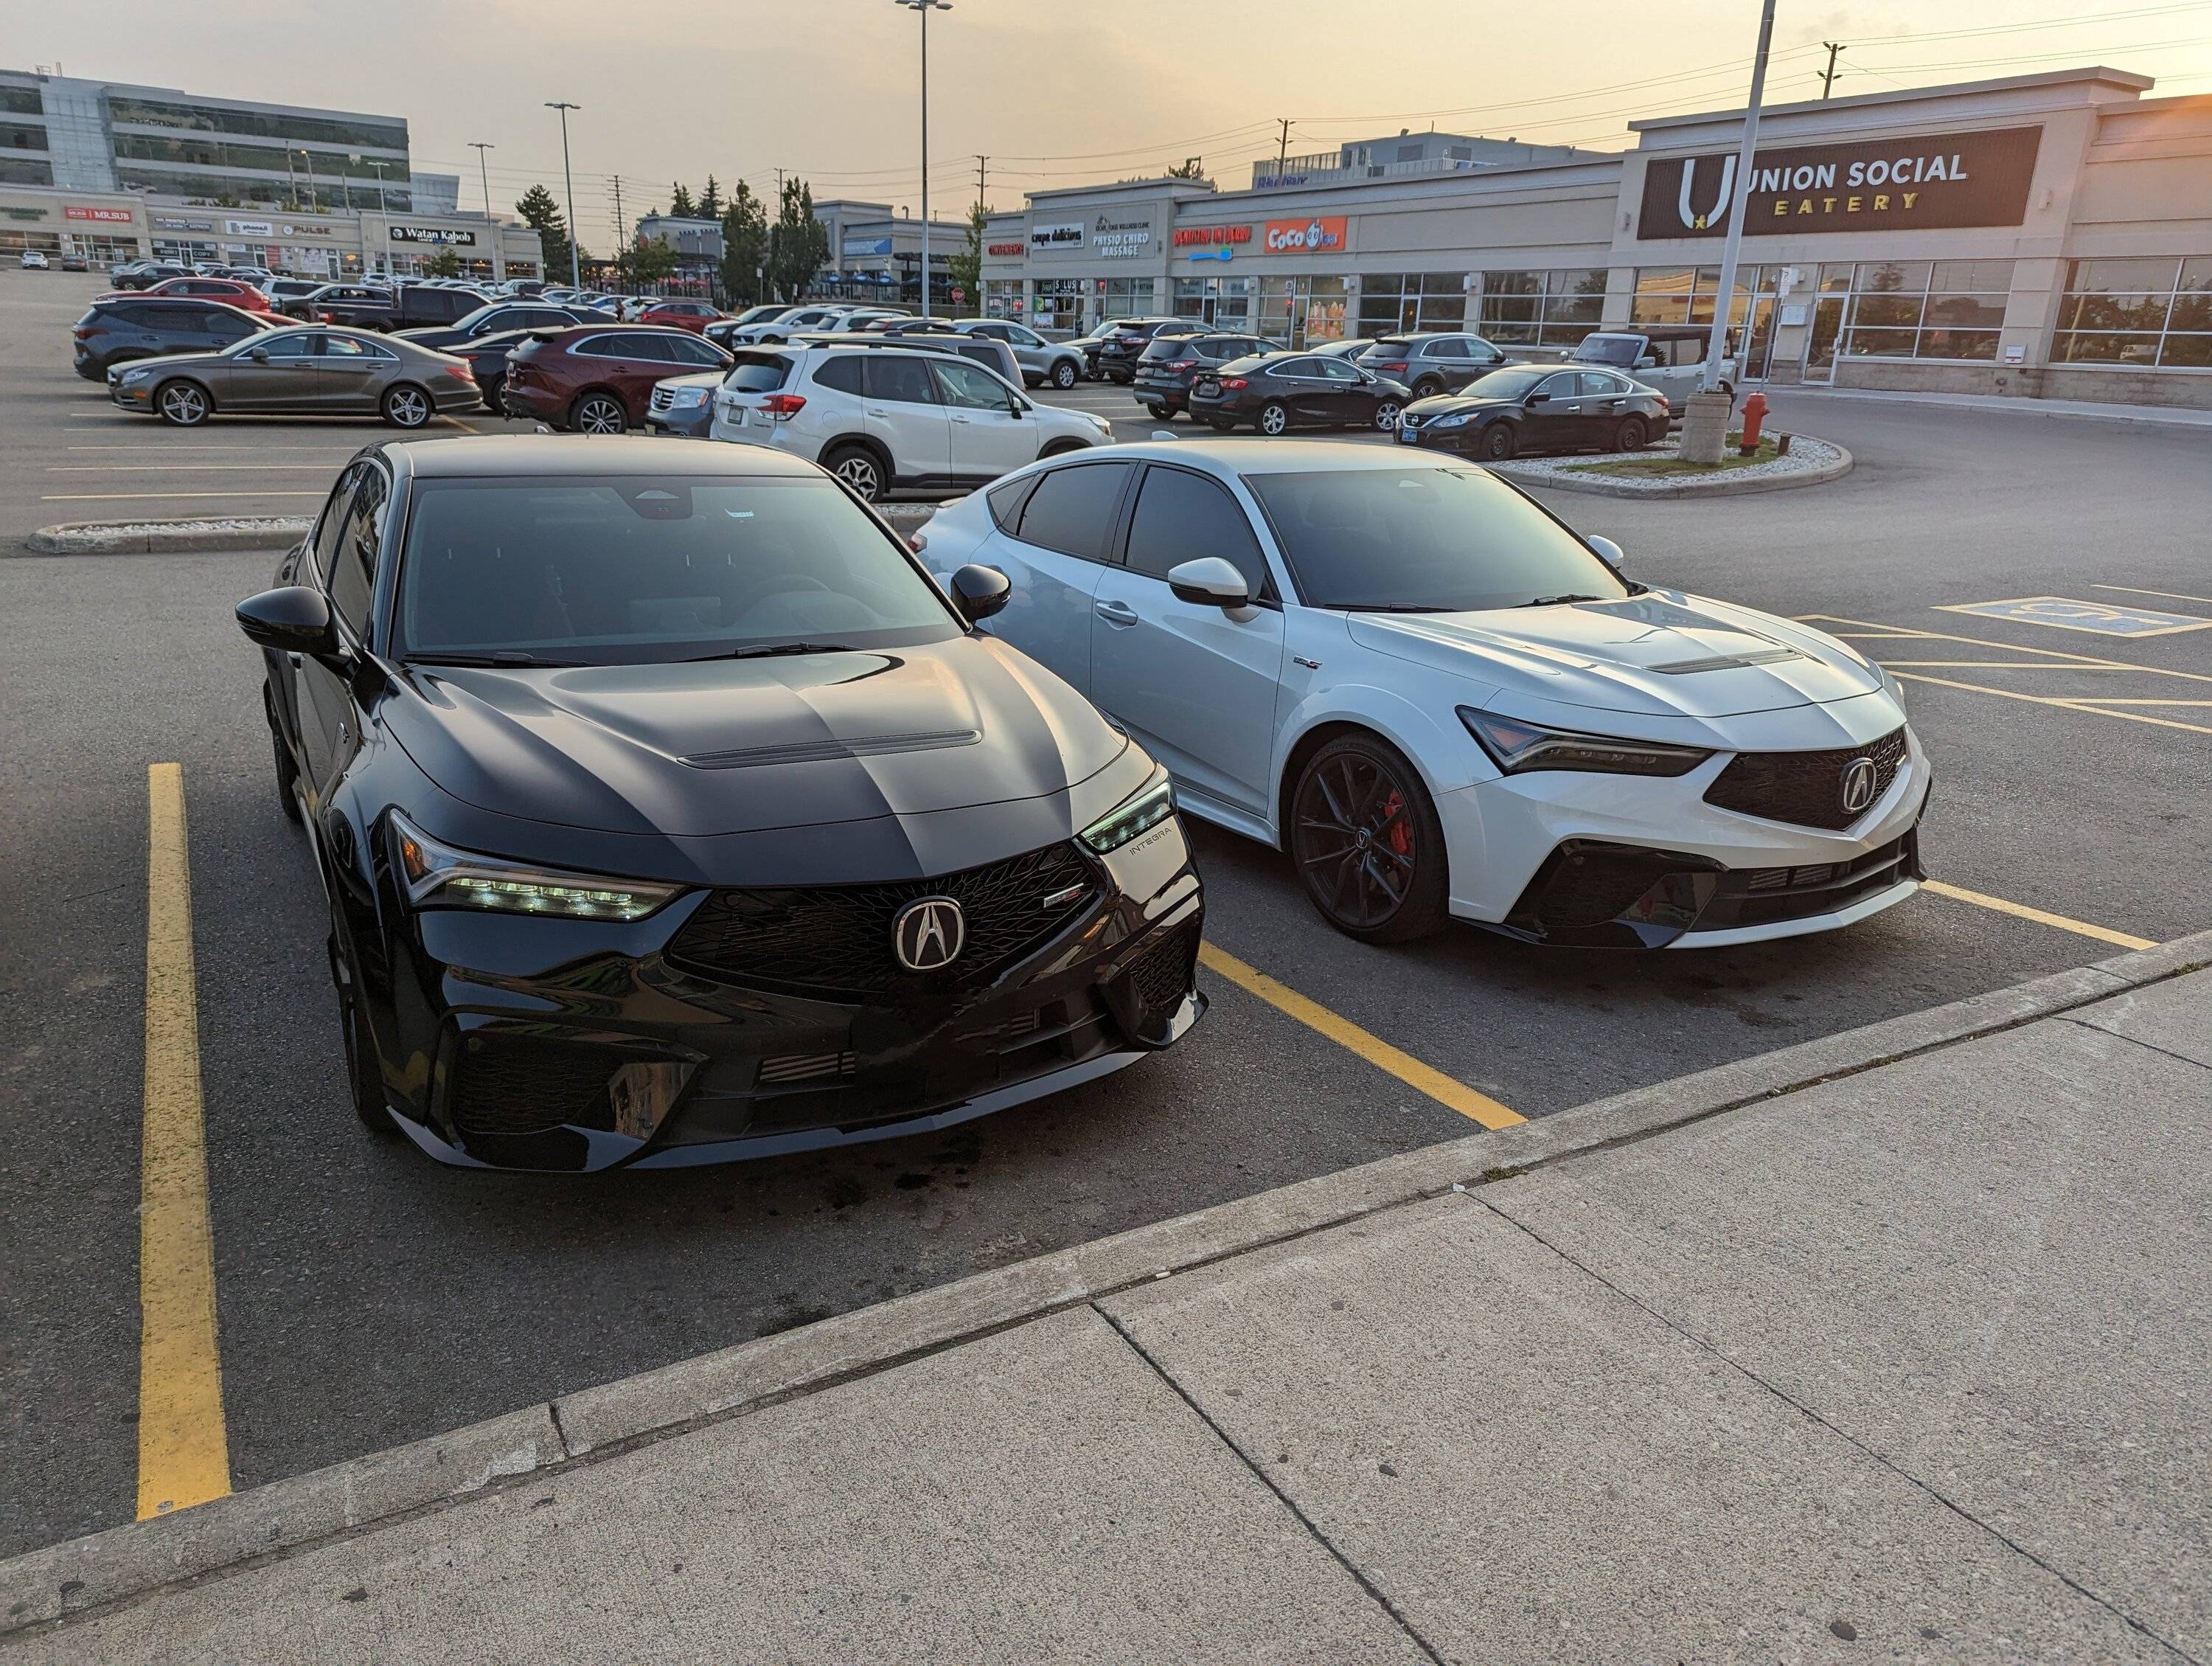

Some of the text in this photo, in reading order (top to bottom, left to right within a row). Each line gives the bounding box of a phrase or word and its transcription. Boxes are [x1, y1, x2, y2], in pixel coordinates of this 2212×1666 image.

[1746, 154, 1968, 194] UNION SOCIAL
[1774, 192, 1919, 215] EATERY
[94, 211, 130, 221] MR.SUB
[293, 225, 331, 235] PULSE
[406, 227, 439, 239] Watan
[440, 230, 471, 242] Kabob
[1093, 232, 1150, 246] PHYSIO CHIRO
[988, 243, 1024, 256] CONVENIENCE
[1102, 244, 1139, 257] MASSAGE
[1771, 274, 1776, 282] 6
[1129, 827, 1172, 855] INTEGRA
